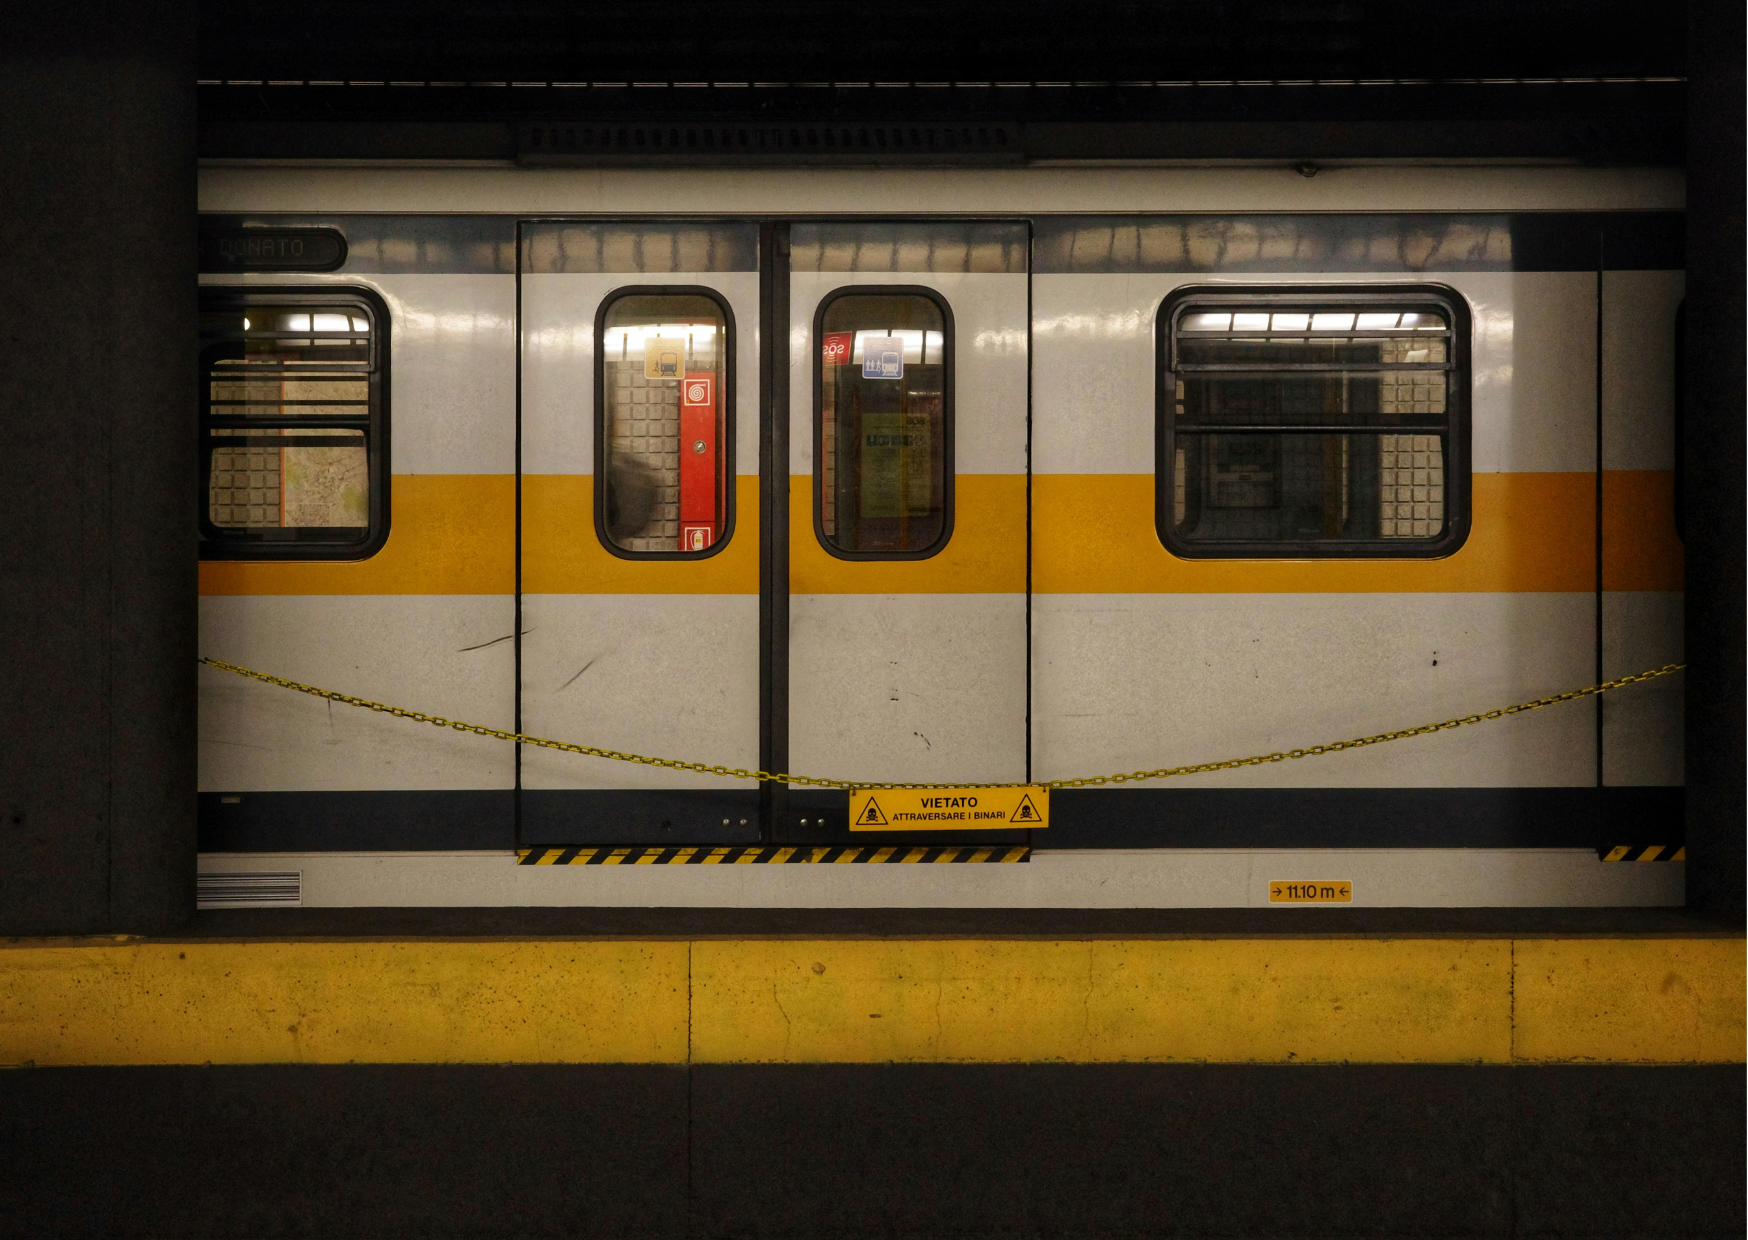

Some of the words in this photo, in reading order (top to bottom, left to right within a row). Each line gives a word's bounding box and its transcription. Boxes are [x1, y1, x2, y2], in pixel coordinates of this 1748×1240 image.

[220, 239, 304, 256] DONATO
[921, 797, 978, 808] VIETATO
[892, 812, 965, 821] ATTRAVERSARE
[973, 811, 1006, 820] BINARI
[1286, 885, 1317, 899] 11.10
[1320, 887, 1335, 899] m
